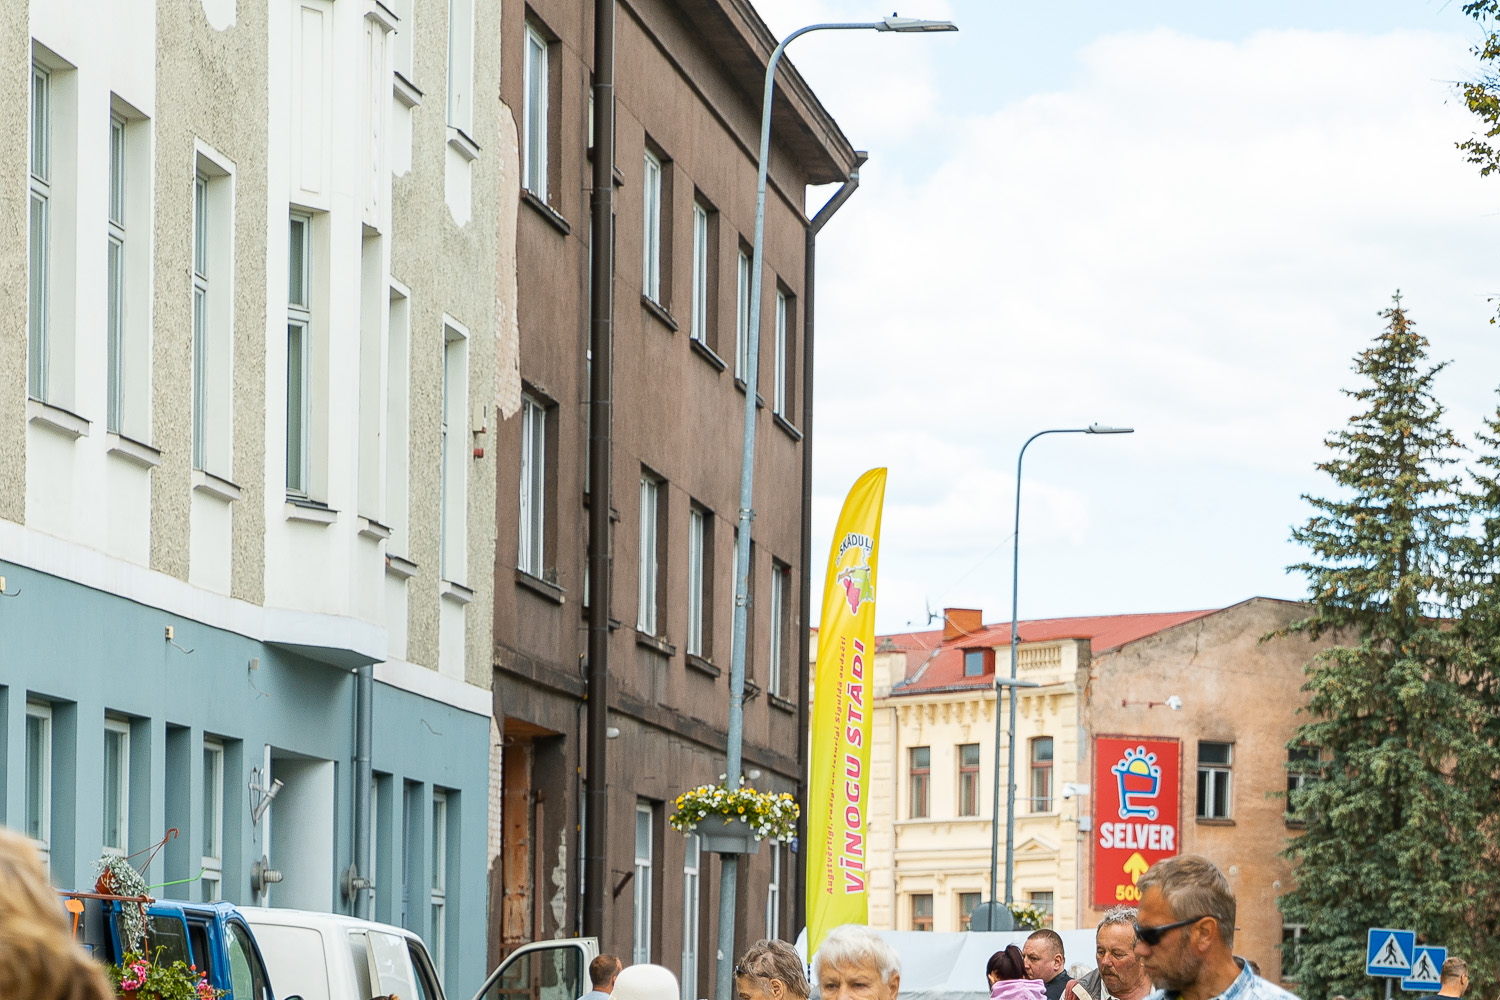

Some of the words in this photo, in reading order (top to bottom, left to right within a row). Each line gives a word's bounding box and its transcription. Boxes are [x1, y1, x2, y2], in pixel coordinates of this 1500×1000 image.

[846, 638, 865, 748] STĀDI
[840, 755, 864, 893] VĪNOGU
[1100, 822, 1175, 851] SELVER
